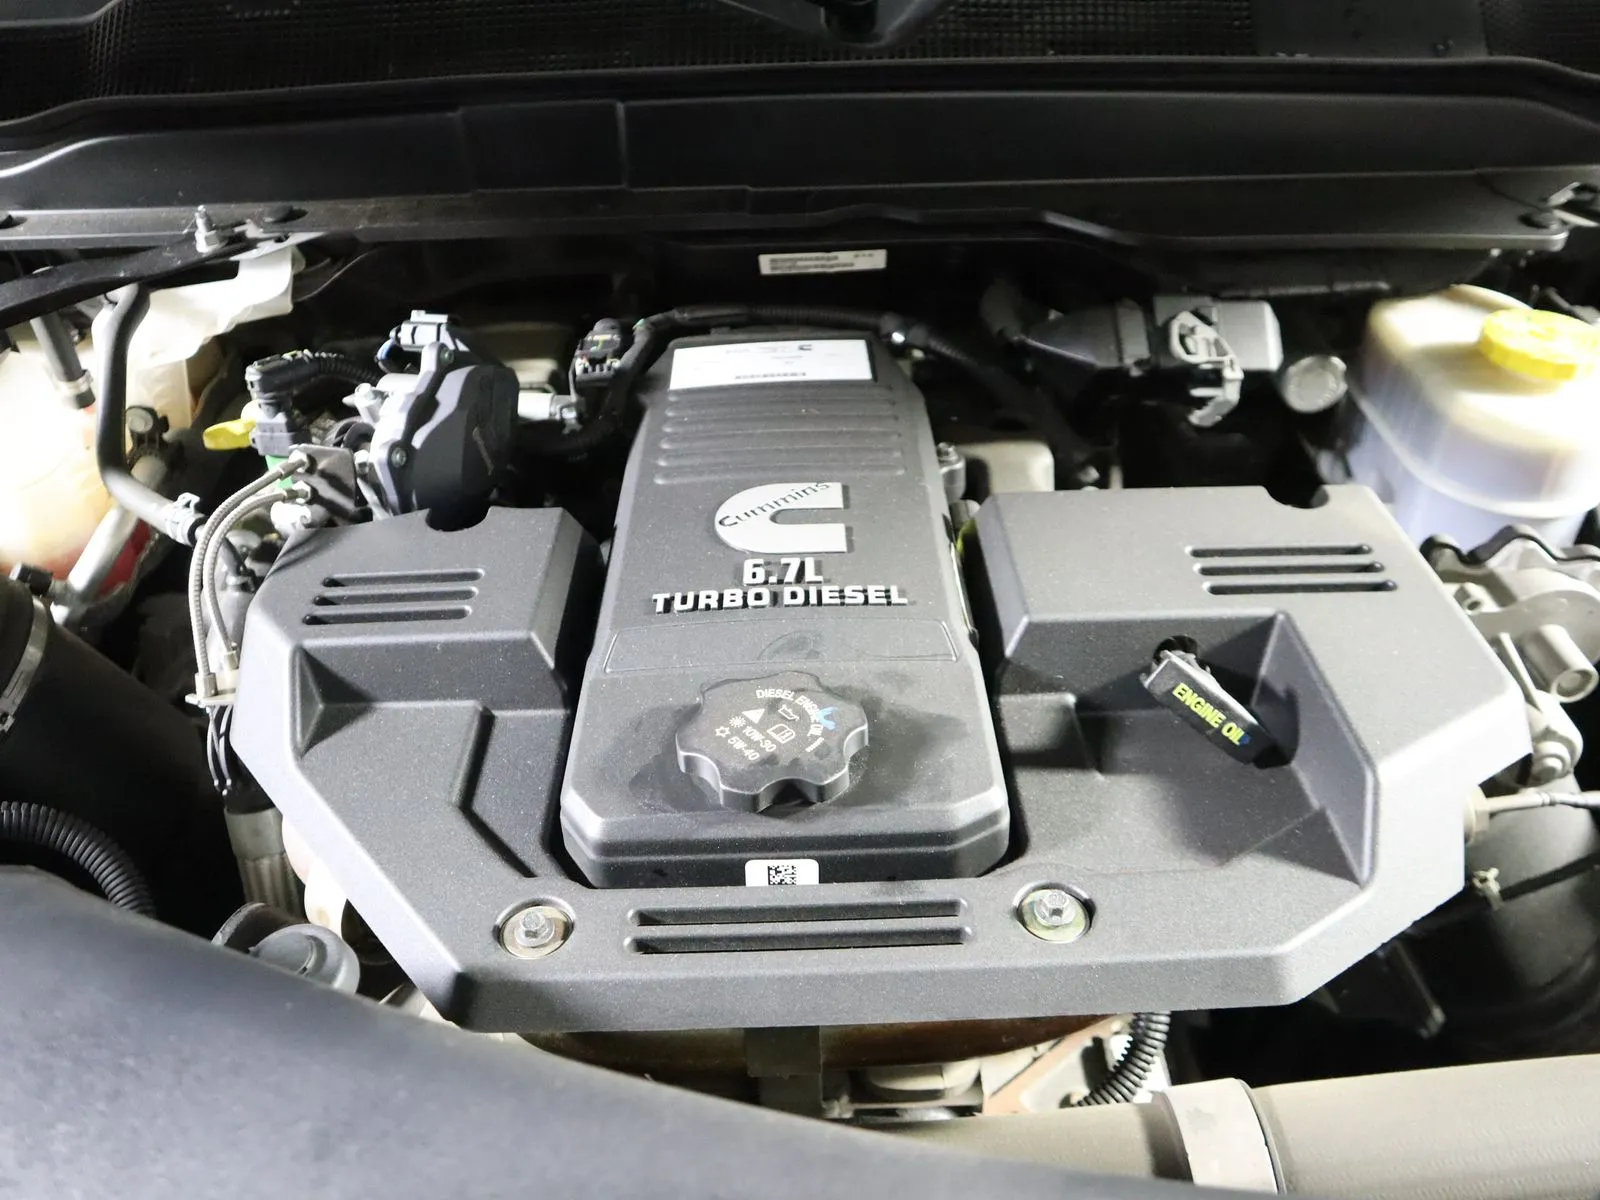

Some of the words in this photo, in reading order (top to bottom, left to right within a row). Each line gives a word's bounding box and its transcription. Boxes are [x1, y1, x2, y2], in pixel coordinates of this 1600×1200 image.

[718, 480, 831, 527] Cummins
[743, 556, 824, 585] 6.7L
[651, 587, 771, 613] TURBO
[783, 584, 909, 607] DIESEL
[755, 688, 795, 701] DIESEL
[1172, 682, 1227, 729] ENGINE
[1221, 721, 1246, 746] OIL
[727, 736, 761, 761] 5W-40
[742, 725, 777, 752] 10W-30
